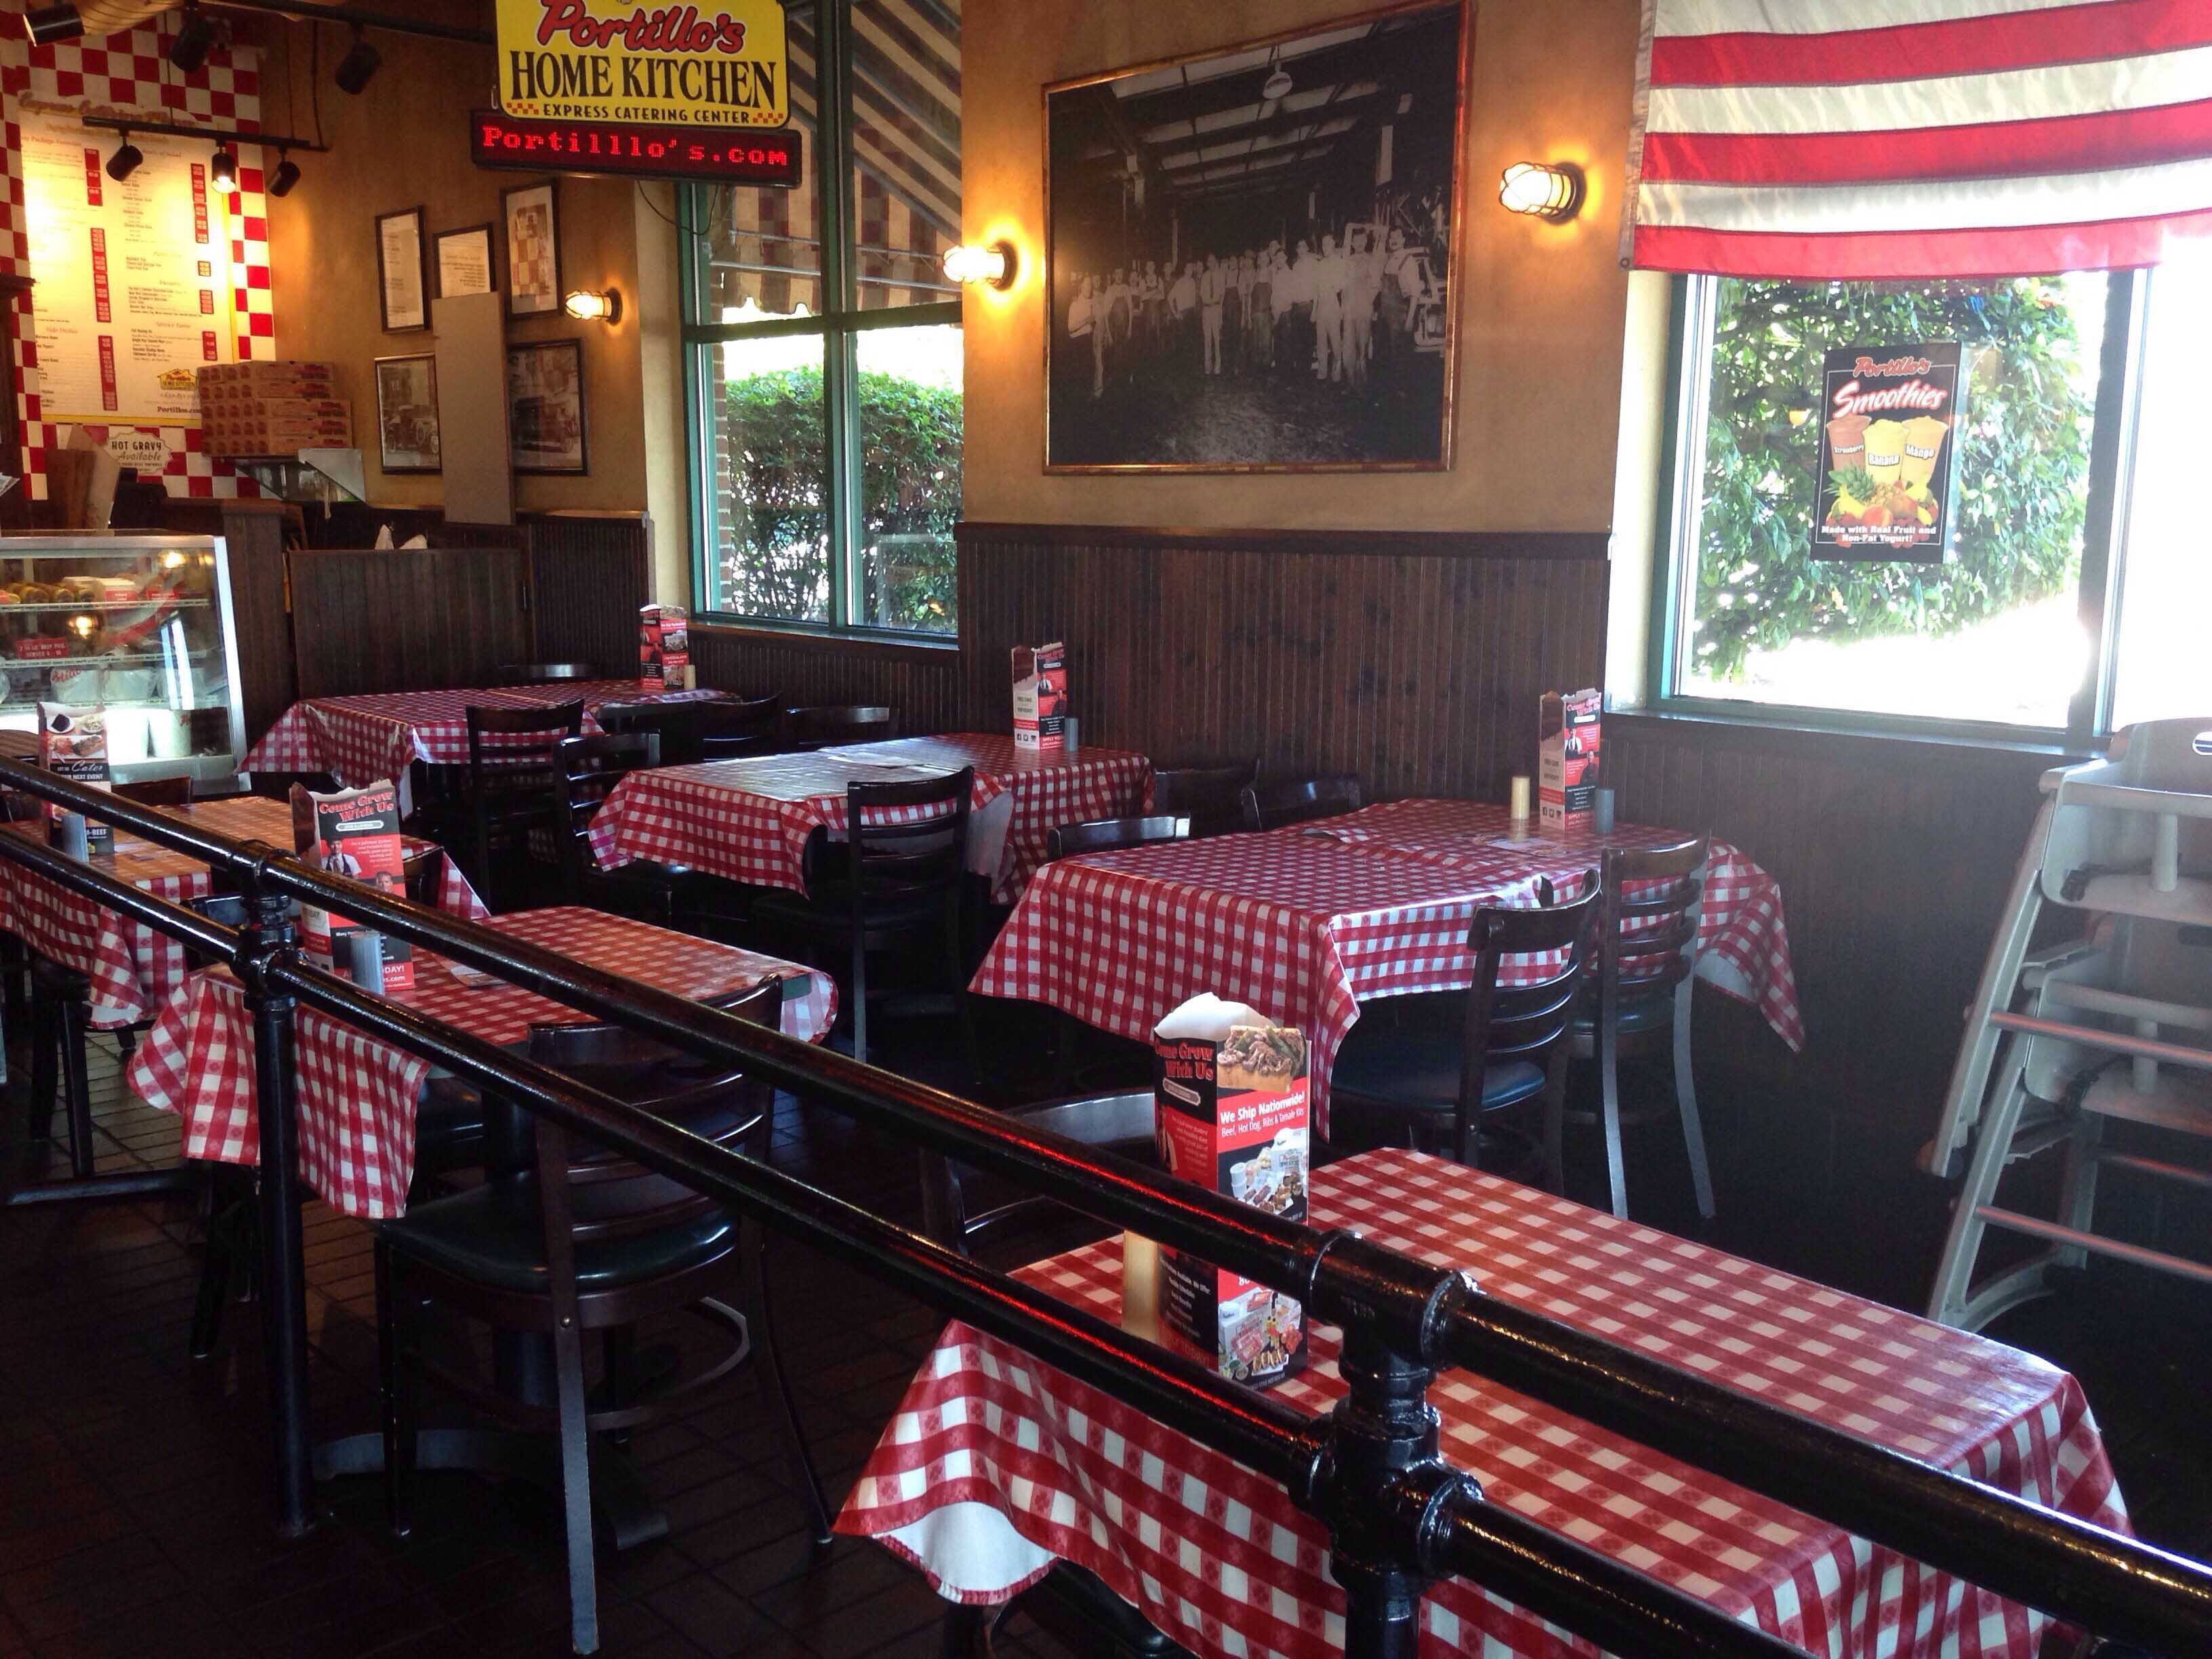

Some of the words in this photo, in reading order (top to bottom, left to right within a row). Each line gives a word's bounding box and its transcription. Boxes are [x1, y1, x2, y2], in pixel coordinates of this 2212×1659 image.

[537, 0, 745, 54] Portillo's
[509, 50, 613, 100] HOME
[620, 56, 777, 110] KITCHEN
[543, 103, 609, 119] EXPRESS
[614, 106, 688, 122] CATERING
[693, 108, 750, 124] CENTER
[1852, 356, 1931, 378] Portillo's
[1832, 379, 1948, 419] Smoothies
[112, 441, 128, 451] HOT
[133, 441, 162, 451] GRAVY
[119, 451, 161, 461] Available
[1833, 445, 1864, 453] Strawberry
[1905, 444, 1936, 459] Mango
[1868, 453, 1900, 466] Banana
[1821, 525, 1845, 534] Made
[1847, 525, 1868, 534] with
[1870, 525, 1891, 534] Real
[1893, 526, 1916, 534] Fruit
[1918, 527, 1937, 535] and
[1841, 534, 1878, 542] Non-Fat
[1879, 534, 1913, 543] Yogurt!
[71, 759, 104, 773] Cater
[319, 801, 356, 814] Come
[357, 792, 393, 806] Grow
[339, 806, 375, 822] With
[375, 801, 394, 813] Us
[1179, 1042, 1214, 1061] Grow
[1165, 1060, 1192, 1078] With
[1194, 1062, 1214, 1082] Us
[1220, 1111, 1235, 1124] We
[1237, 1106, 1256, 1123] Ship
[1258, 1091, 1305, 1115] Nationwide!
[1221, 1126, 1237, 1138] Beef,
[1238, 1123, 1248, 1133] Hot
[1249, 1121, 1261, 1132] Dog,
[1263, 1118, 1274, 1129] Ribs
[1274, 1116, 1279, 1124] &
